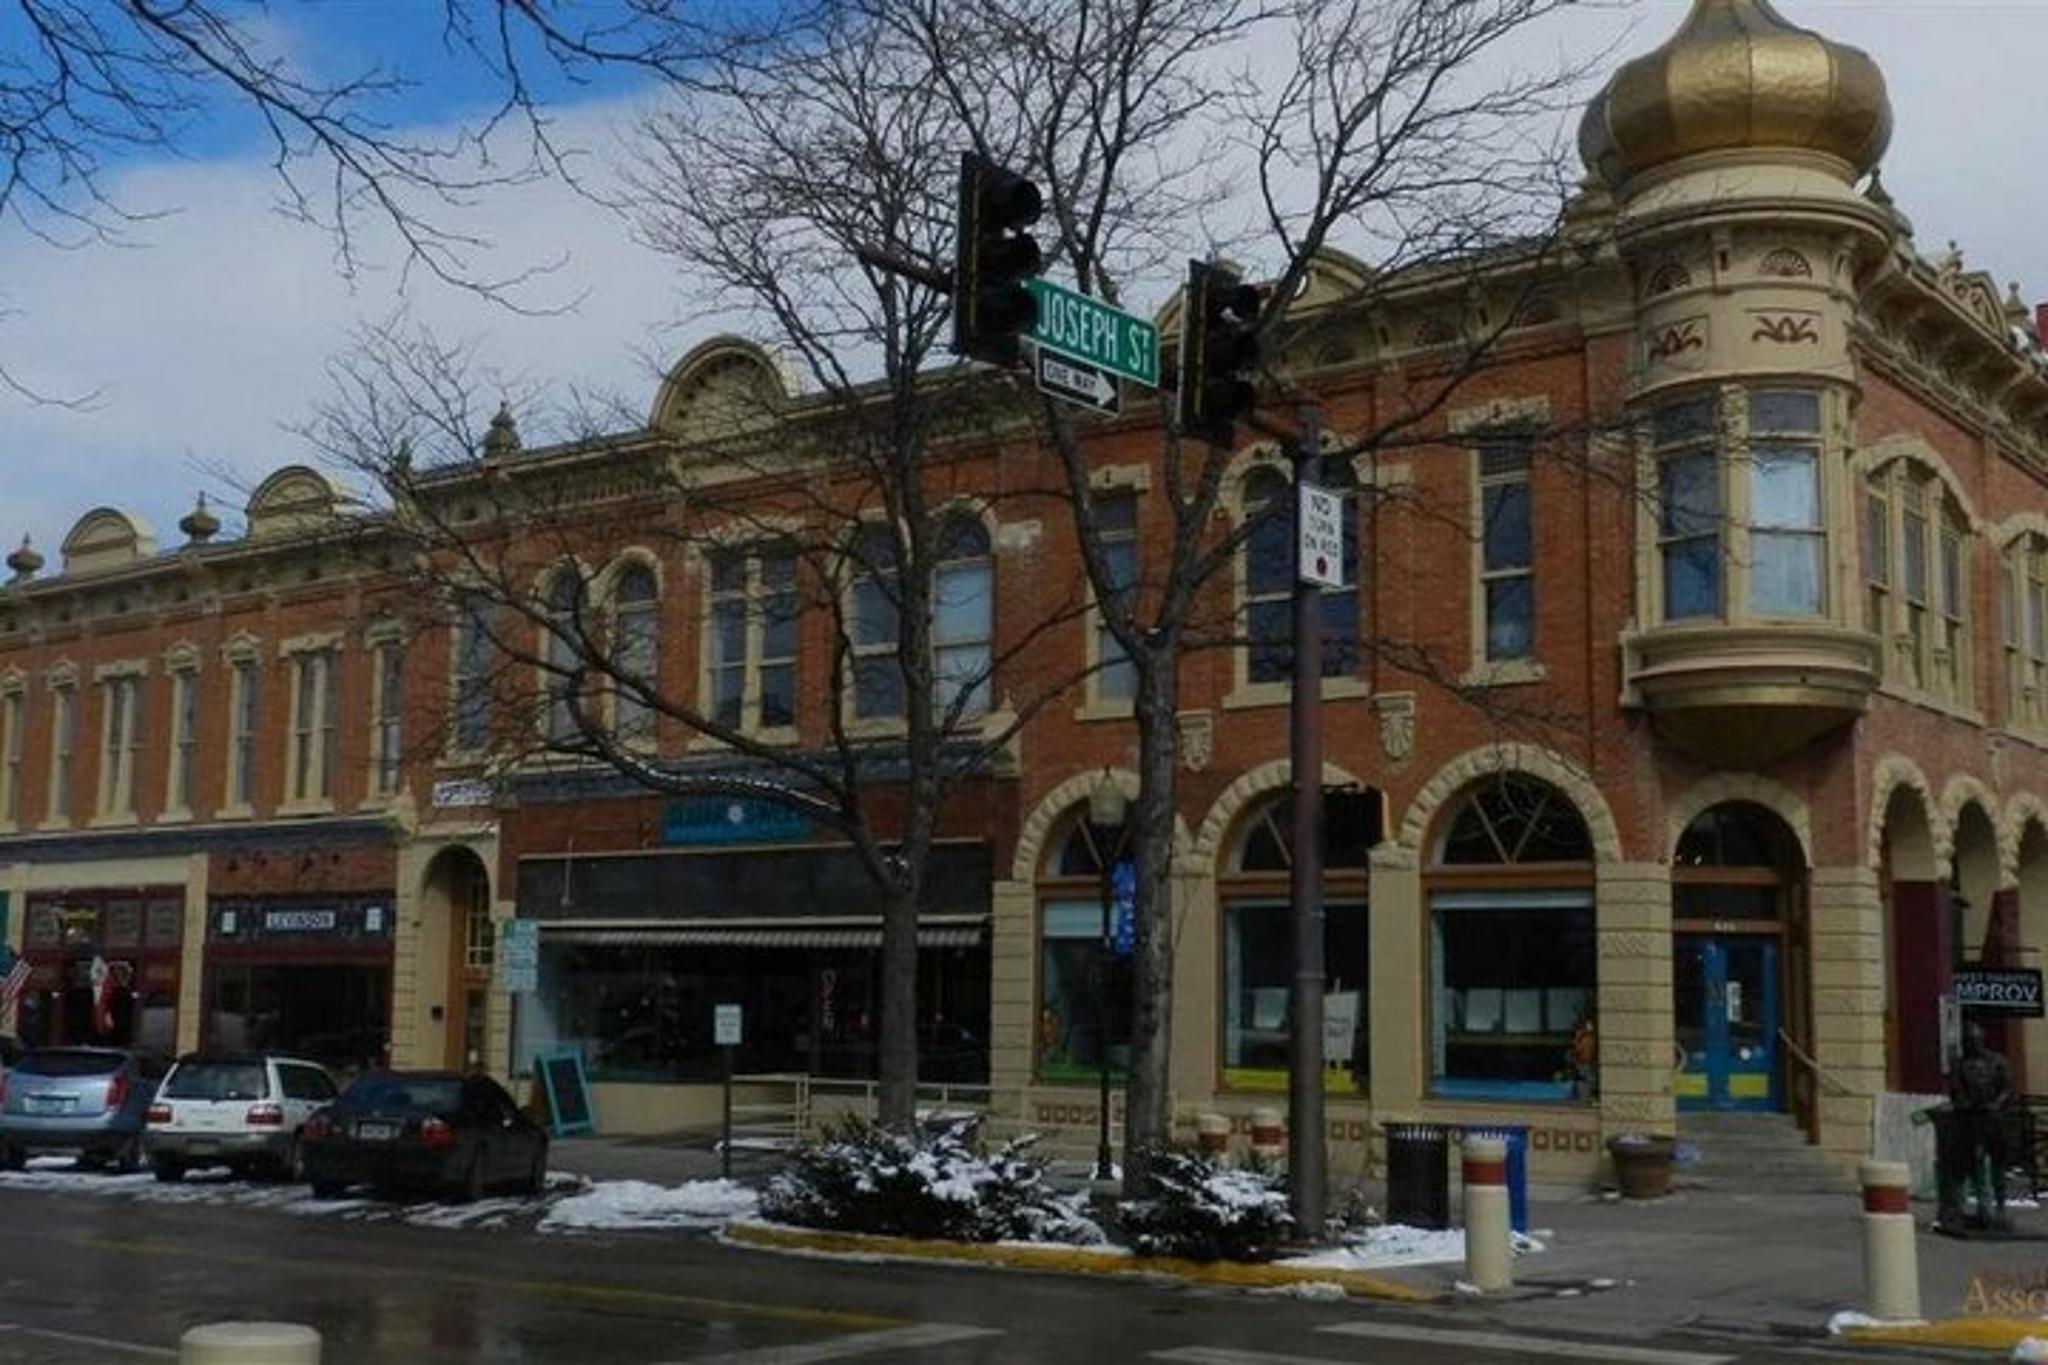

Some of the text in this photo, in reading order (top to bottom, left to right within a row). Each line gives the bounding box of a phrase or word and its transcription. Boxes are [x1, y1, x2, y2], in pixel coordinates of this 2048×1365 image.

[1037, 289, 1151, 374] JOSEPH ST
[1046, 362, 1069, 386] ONE
[1311, 494, 1331, 515] NO
[1956, 982, 2038, 1002] MPROV
